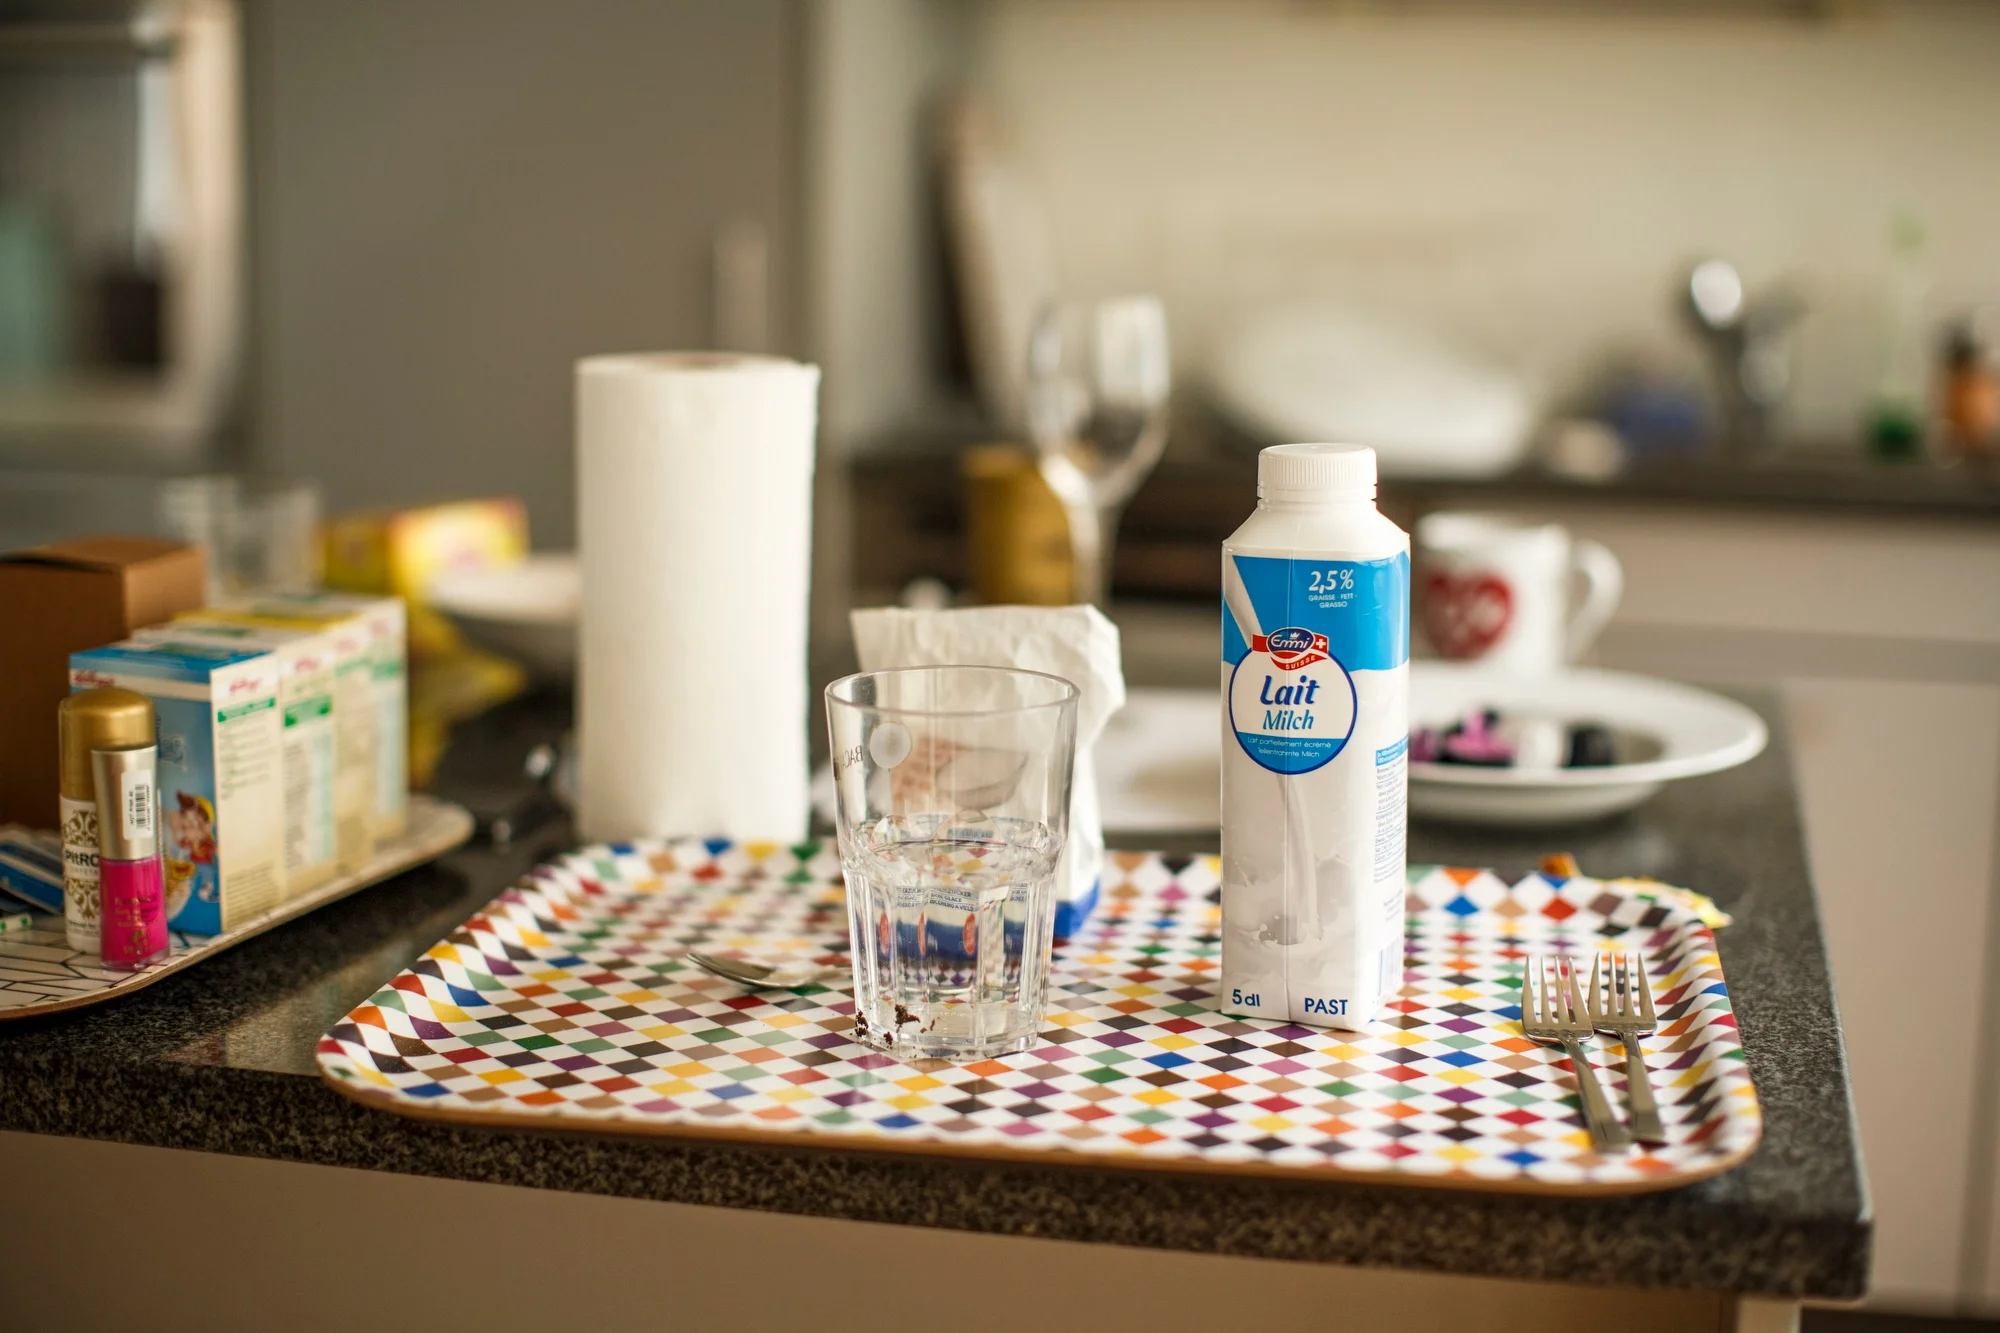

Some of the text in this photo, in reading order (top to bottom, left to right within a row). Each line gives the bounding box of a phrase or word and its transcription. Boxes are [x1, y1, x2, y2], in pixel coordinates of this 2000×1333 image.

[1308, 569, 1354, 594] 2,5%
[1308, 594, 1336, 602] GRAISSE
[1270, 634, 1310, 649] Emmi
[1285, 655, 1316, 670] SUISSE
[1260, 675, 1320, 705] Lait
[1262, 709, 1314, 730] Milch
[1259, 738, 1302, 748] partiellement
[1301, 750, 1320, 758] Milch
[1304, 997, 1348, 1015] PAST
